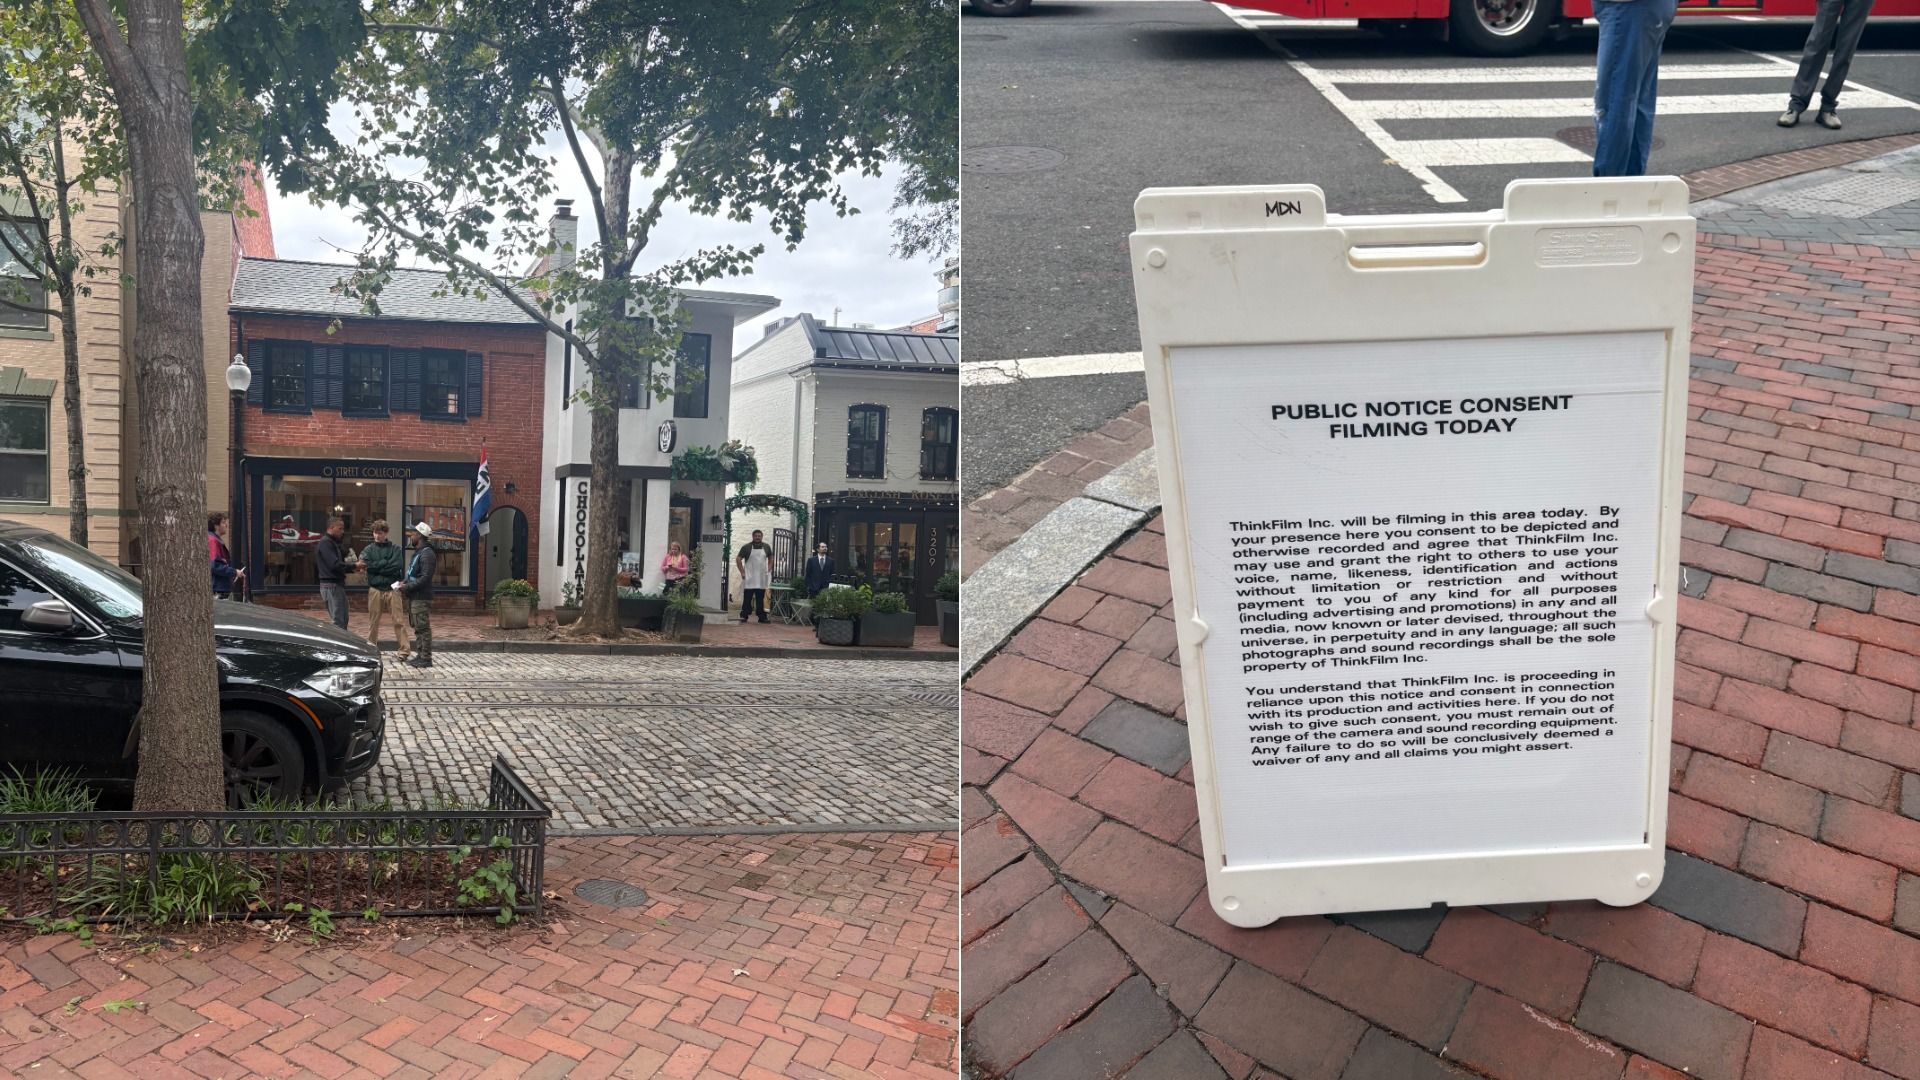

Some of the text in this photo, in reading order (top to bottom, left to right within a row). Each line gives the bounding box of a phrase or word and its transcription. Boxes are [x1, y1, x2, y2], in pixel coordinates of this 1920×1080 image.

[1265, 200, 1302, 218] MDN
[1271, 395, 1574, 420] PUBLIC NOTICE CONSENT
[1329, 417, 1518, 438] FILMING TODAY
[323, 466, 411, 478] O STREET COLLECTION
[1228, 505, 1620, 532] ThinkFilm Inc. will be filming in this area today. By
[575, 481, 588, 600] CHOCOLATE
[1231, 518, 1619, 547] your presence here you consent to be depicted and
[1232, 532, 1618, 559] otherwise recorded and agree that ThinkFilm Inc.
[928, 527, 937, 567] 3209
[1233, 546, 1619, 572] may use and grant the right to others to use your
[1235, 571, 1618, 597] without limitation or restriction and without
[1237, 584, 1617, 612] payment to you of any kind for all purposes
[1239, 594, 1617, 624] (including advertising and promotions) in any and all
[1242, 632, 1616, 662] photographs and sound recordings shall be the sole
[1243, 654, 1428, 674] property of ThinkFilm Inc.
[1245, 668, 1615, 696] You understand that ThinkFilm Inc. is proceeding in
[1246, 681, 1615, 708] reliance upon this notice and consent in connection
[1247, 692, 1615, 720] with its production and activities here. If you do not
[1248, 721, 1283, 732] wish
[1287, 721, 1304, 730] to
[1308, 718, 1338, 730] give
[1343, 716, 1376, 727] such
[1446, 712, 1472, 723] you
[1477, 709, 1513, 719] must
[1518, 706, 1567, 717] remain
[1571, 705, 1595, 715] out
[1599, 703, 1615, 713] of
[1250, 716, 1618, 744] range of the camera and sound recording equipment.
[1251, 745, 1280, 756] Any
[1285, 743, 1331, 753] failure
[1336, 742, 1352, 750] to
[1356, 739, 1375, 749] do
[1380, 740, 1396, 748] so
[1401, 736, 1426, 746] will
[1431, 735, 1449, 745] be
[1454, 730, 1538, 744] conclusively
[1543, 727, 1600, 739] deemed
[1252, 741, 1573, 766] waiver of any and all claims you might assert.
